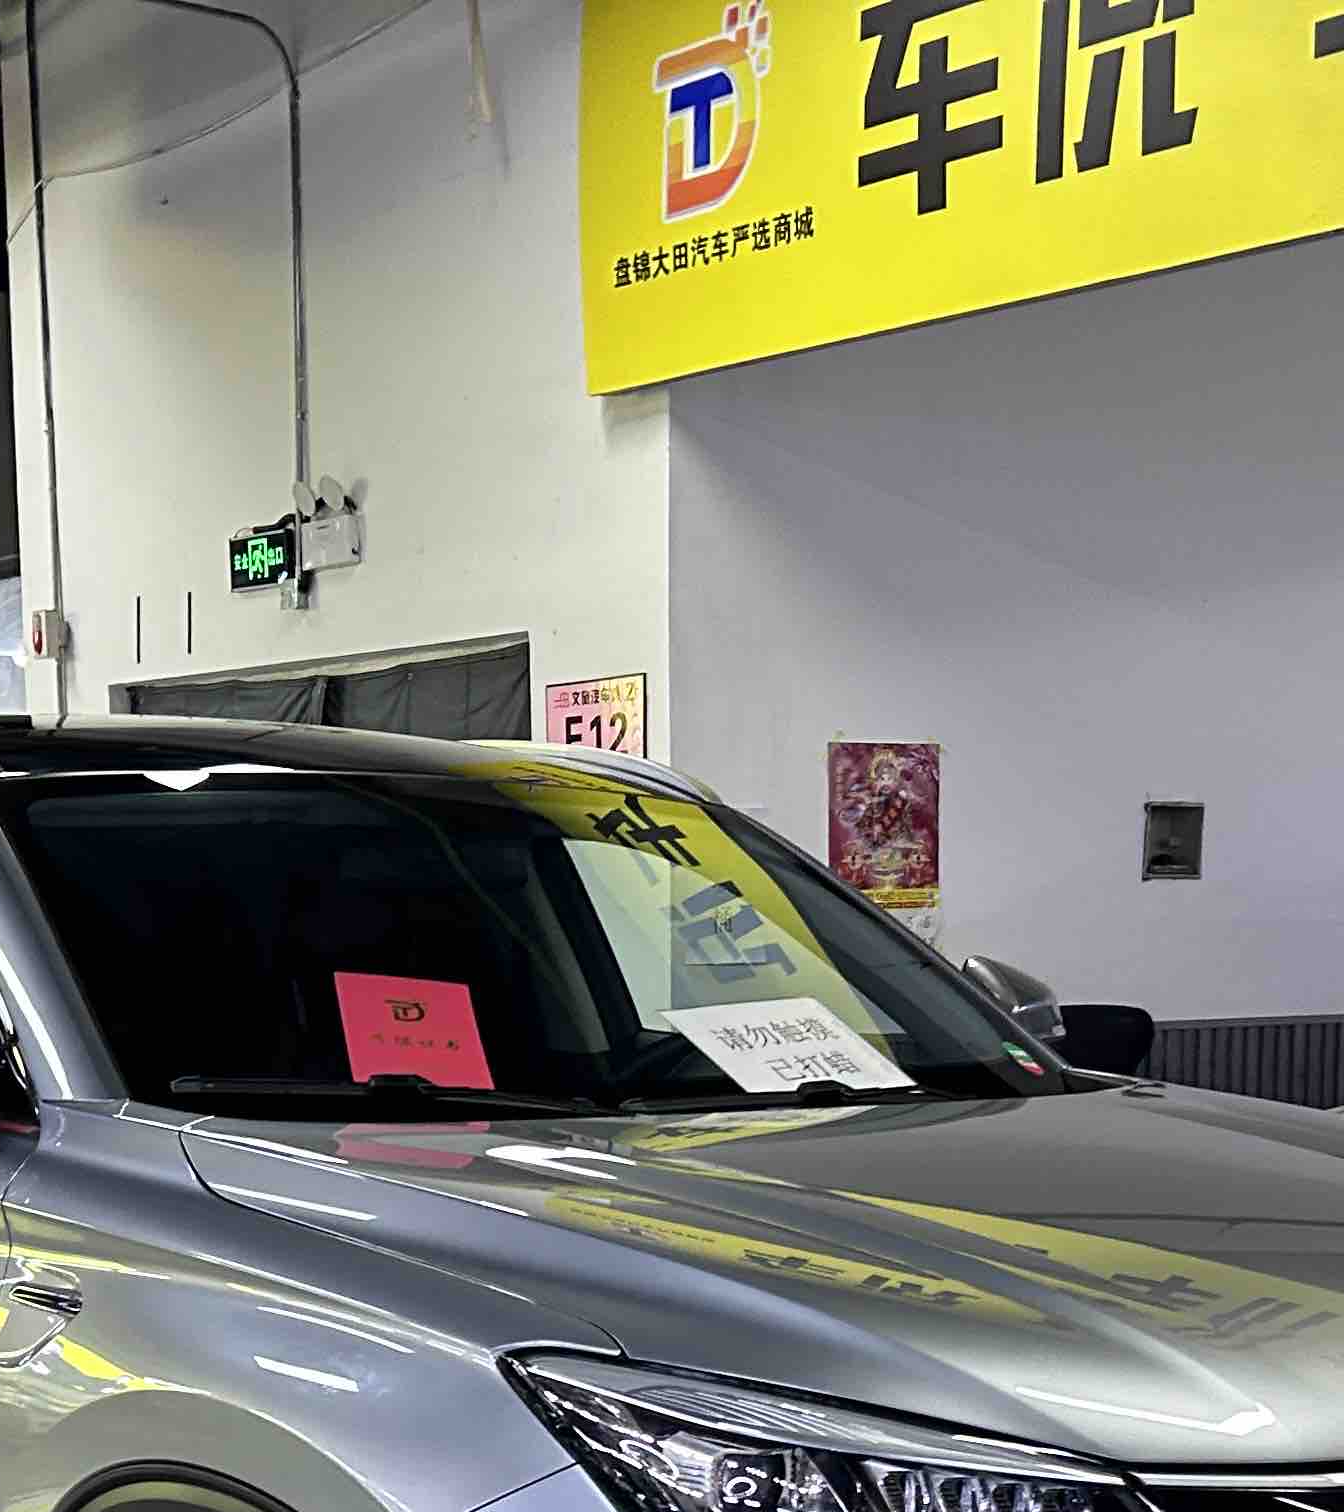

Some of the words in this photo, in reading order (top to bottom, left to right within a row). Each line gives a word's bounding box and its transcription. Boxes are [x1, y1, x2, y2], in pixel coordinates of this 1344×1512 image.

[613, 206, 815, 289] 盘锦大田汽车严选商城
